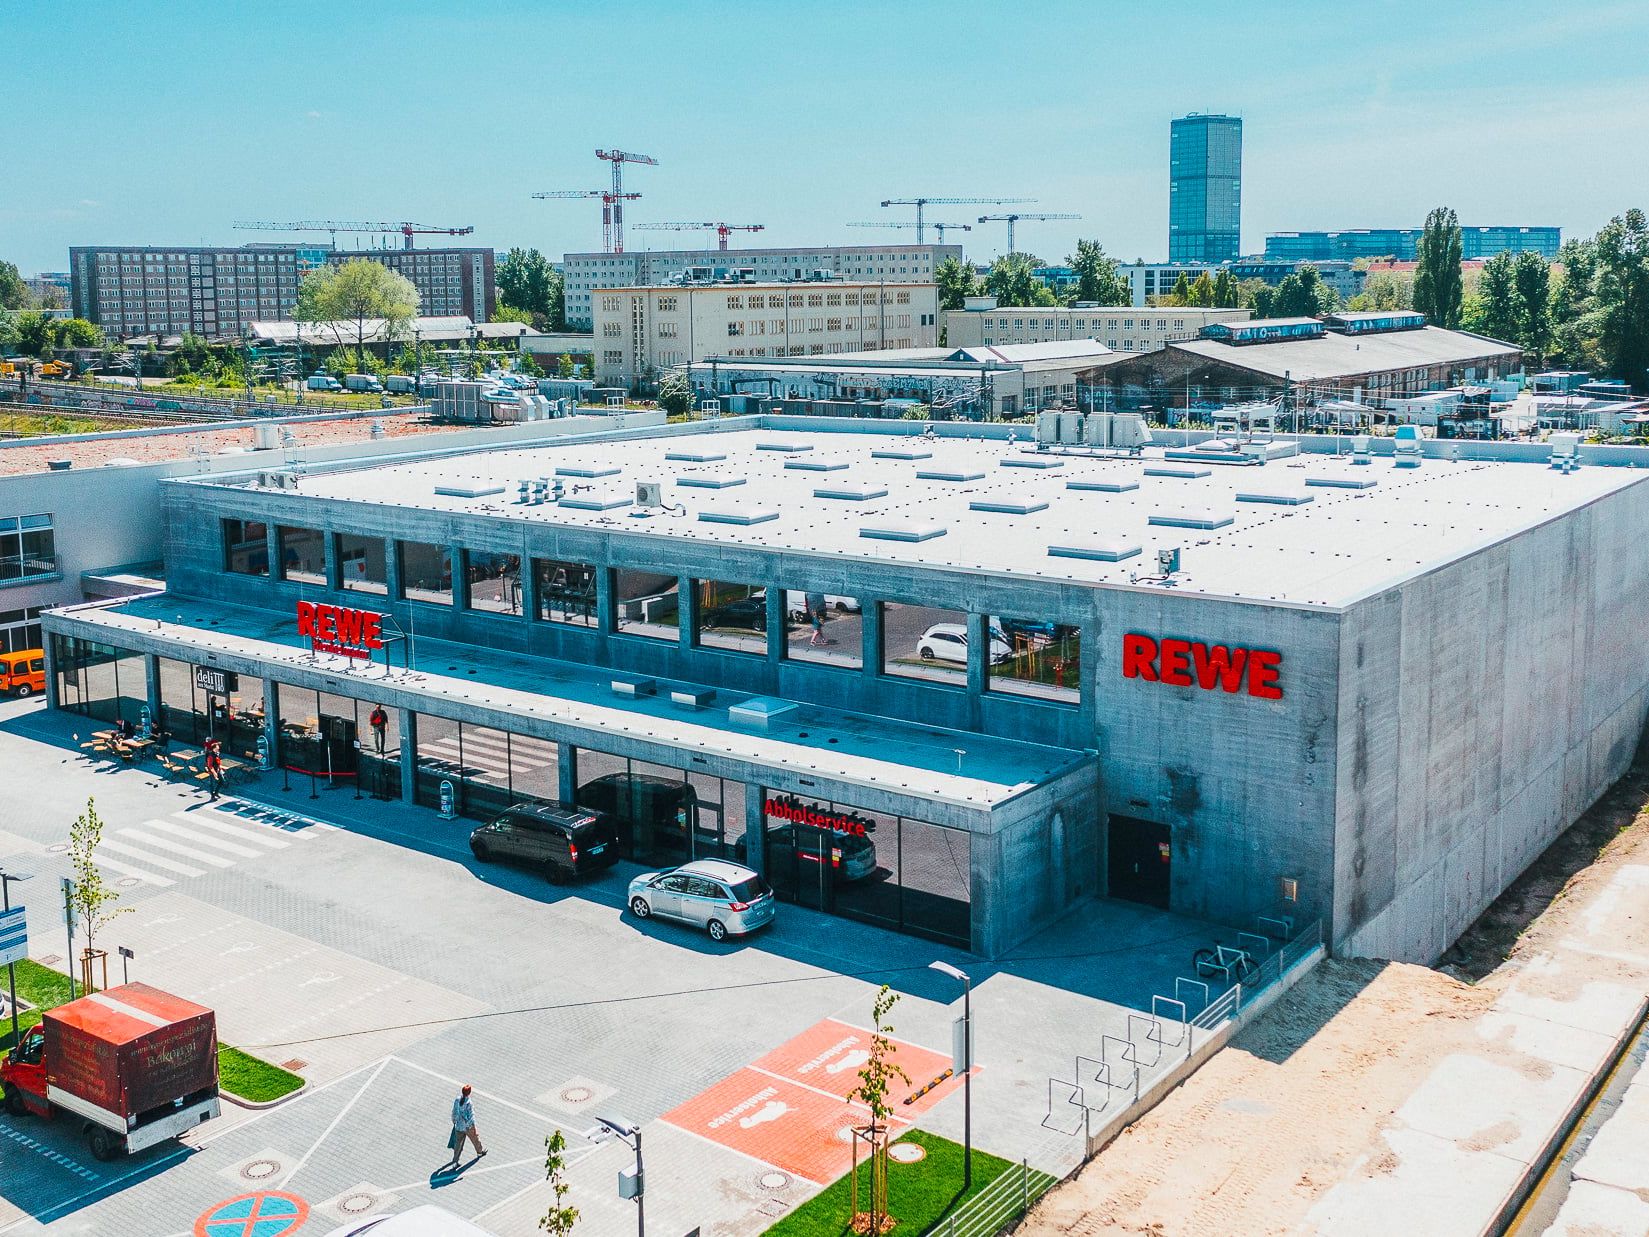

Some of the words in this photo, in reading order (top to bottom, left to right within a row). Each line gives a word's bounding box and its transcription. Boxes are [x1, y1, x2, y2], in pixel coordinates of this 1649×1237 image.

[297, 600, 383, 649] REWE
[197, 669, 214, 685] deli
[1122, 633, 1283, 699] REWE
[764, 799, 865, 838] Abholservice
[707, 1086, 779, 1129] Abholservice
